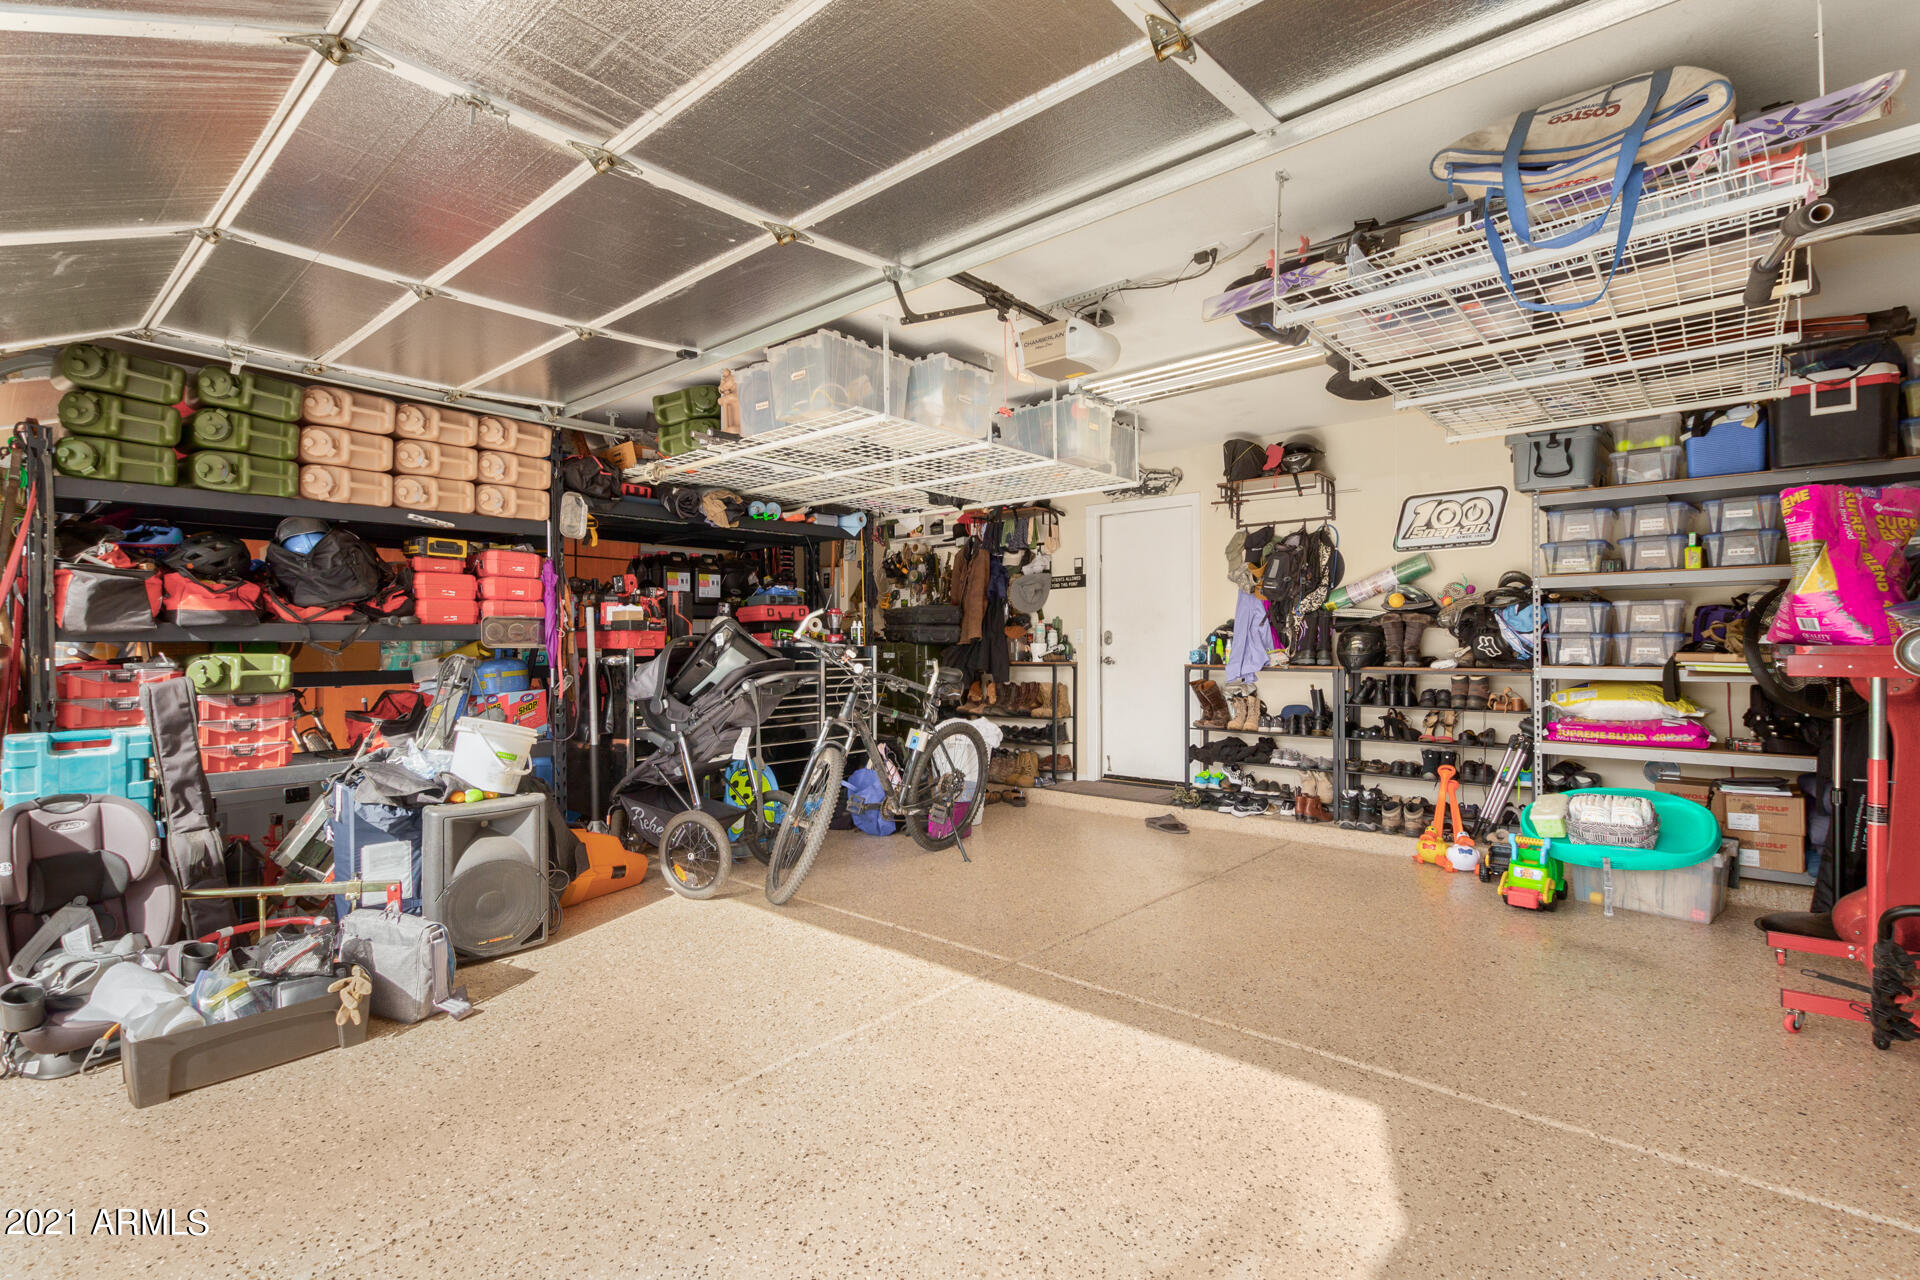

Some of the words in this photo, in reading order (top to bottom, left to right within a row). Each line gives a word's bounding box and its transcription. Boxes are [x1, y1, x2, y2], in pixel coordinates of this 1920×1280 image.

[1547, 103, 1621, 125] COSTCO
[1023, 331, 1065, 348] CHAMBERLAIN
[1402, 496, 1494, 539] 100
[518, 700, 538, 715] SHOP
[1608, 731, 1648, 742] BLEND
[1756, 804, 1790, 812] WOLF
[1755, 841, 1788, 849] WOLF
